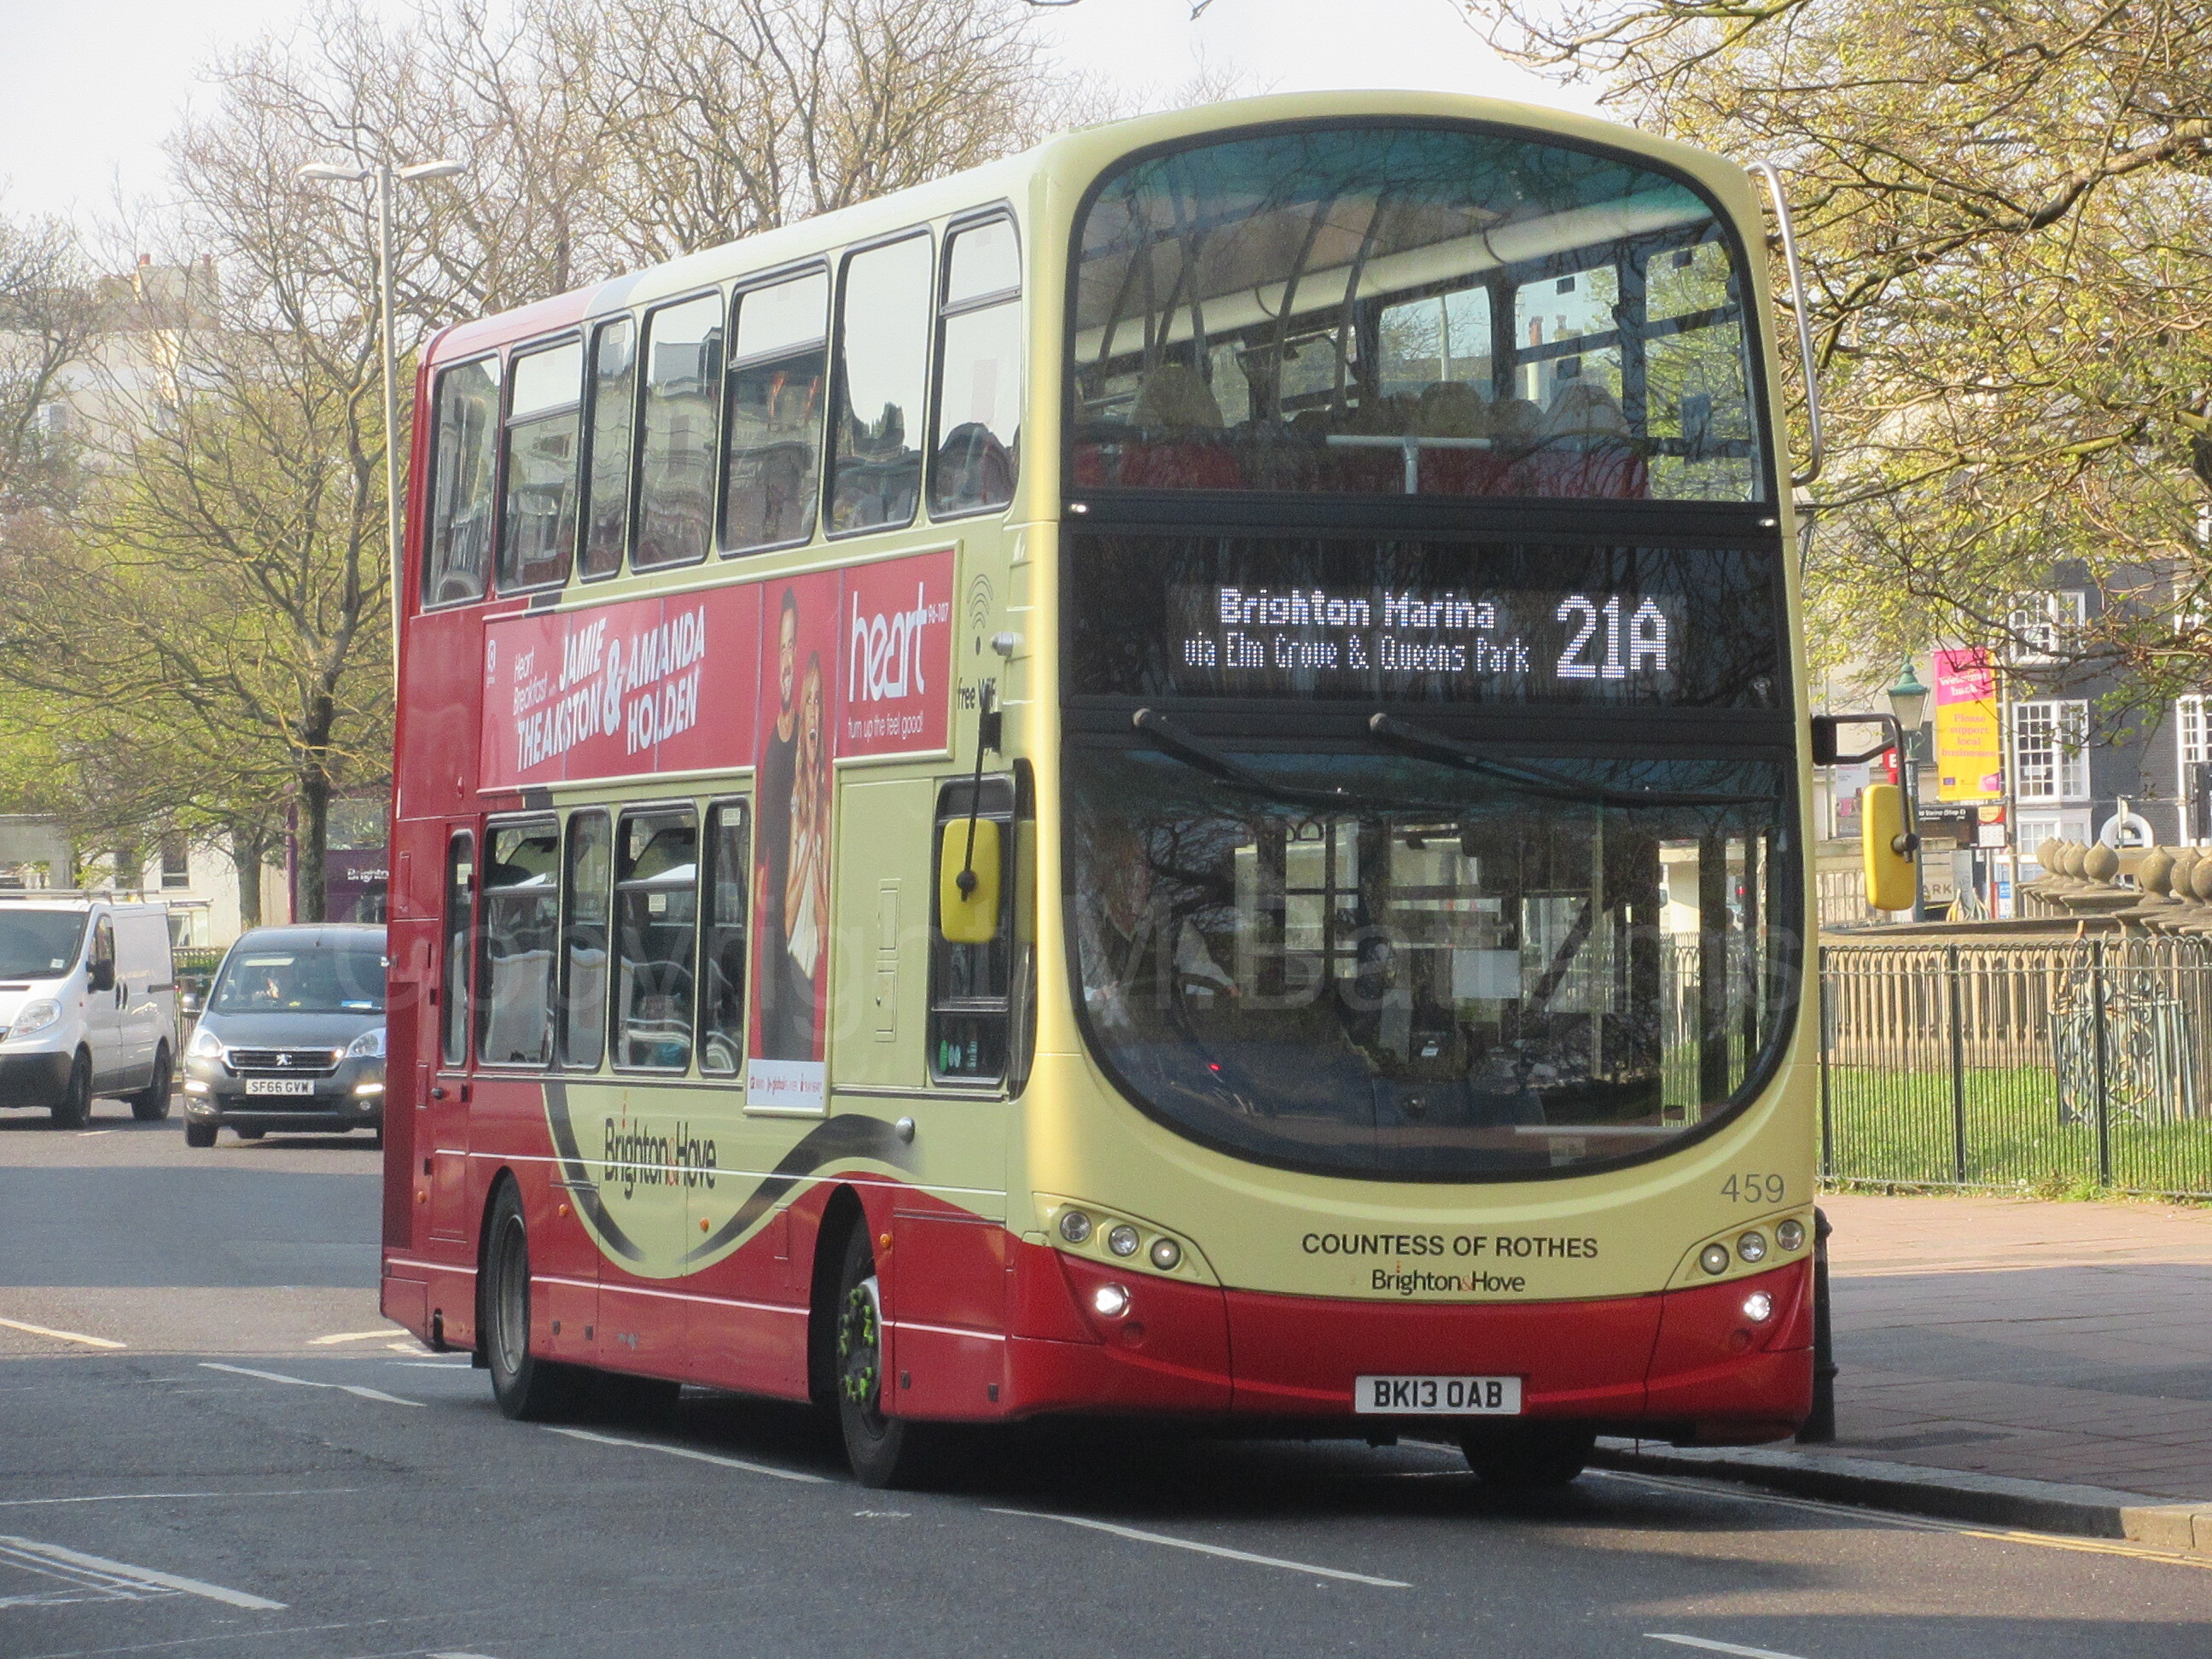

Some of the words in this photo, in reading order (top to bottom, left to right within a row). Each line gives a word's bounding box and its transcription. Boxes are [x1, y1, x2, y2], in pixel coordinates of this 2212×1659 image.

[1220, 588, 1370, 627] Brighton
[1384, 591, 1495, 630] Marina
[625, 604, 706, 694] AMANDA
[848, 581, 928, 702] heart
[1185, 632, 1217, 667] via
[1226, 632, 1265, 669] Elm
[1273, 632, 1338, 669] Grove
[1348, 632, 1370, 670] &
[1380, 634, 1467, 672] Queens
[1476, 637, 1531, 673] Park
[1555, 594, 1668, 679] 21A
[559, 617, 607, 692] JAMIE
[602, 637, 624, 736] &
[957, 677, 975, 710] free
[1951, 683, 1978, 696] back
[517, 678, 602, 772] THEAKSTON
[626, 664, 701, 756] HOLDEN
[1954, 713, 1986, 723] Please
[1941, 748, 1996, 757] businesses
[1957, 736, 1981, 745] local
[251, 1081, 282, 1093] SF66
[1720, 1173, 1785, 1204] 459
[1301, 1233, 1445, 1257] COUNTESS
[1453, 1235, 1488, 1257] OF
[1495, 1236, 1599, 1259] ROTHES
[1371, 1263, 1526, 1296] Brighton&Hove
[1373, 1379, 1439, 1408] BK13
[1447, 1379, 1504, 1408] OAB
